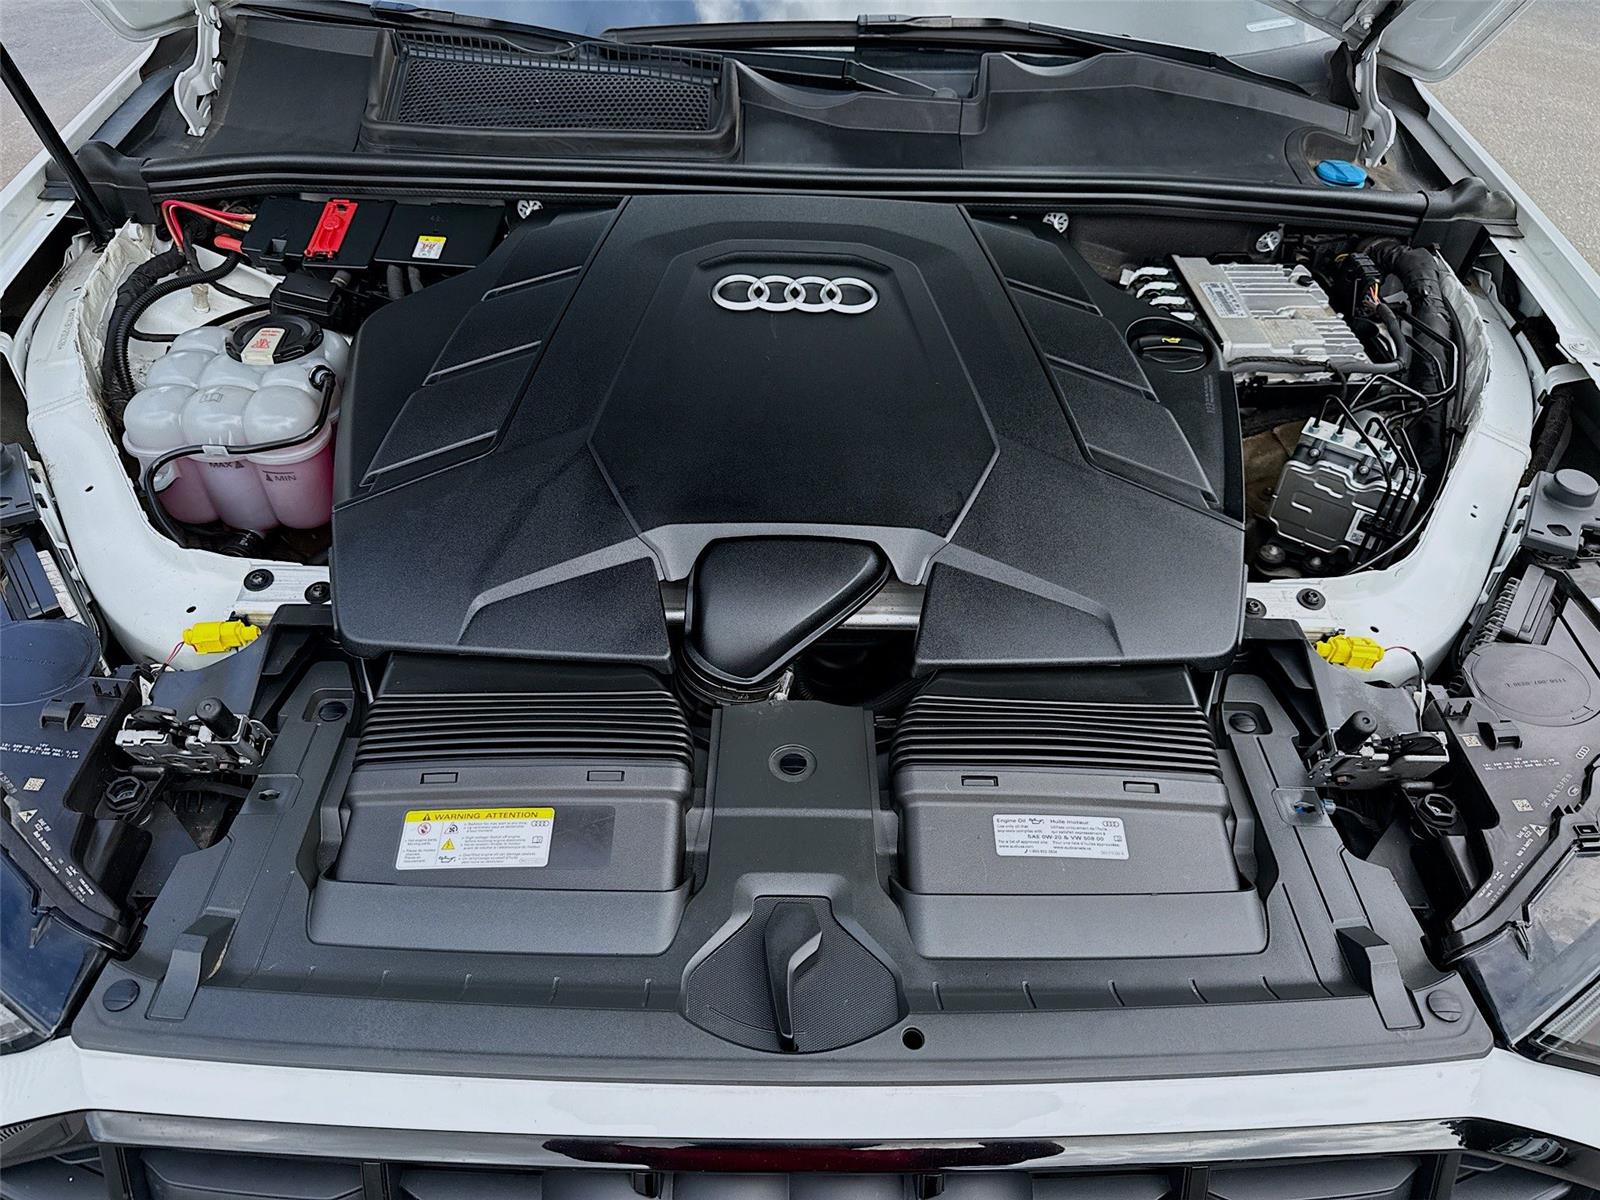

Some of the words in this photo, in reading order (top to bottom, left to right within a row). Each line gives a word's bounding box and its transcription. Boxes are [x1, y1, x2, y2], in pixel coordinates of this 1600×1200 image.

[208, 461, 233, 469] MAX
[274, 474, 297, 482] MIN
[434, 812, 481, 821] WARNING
[485, 811, 538, 820] ATTENTION
